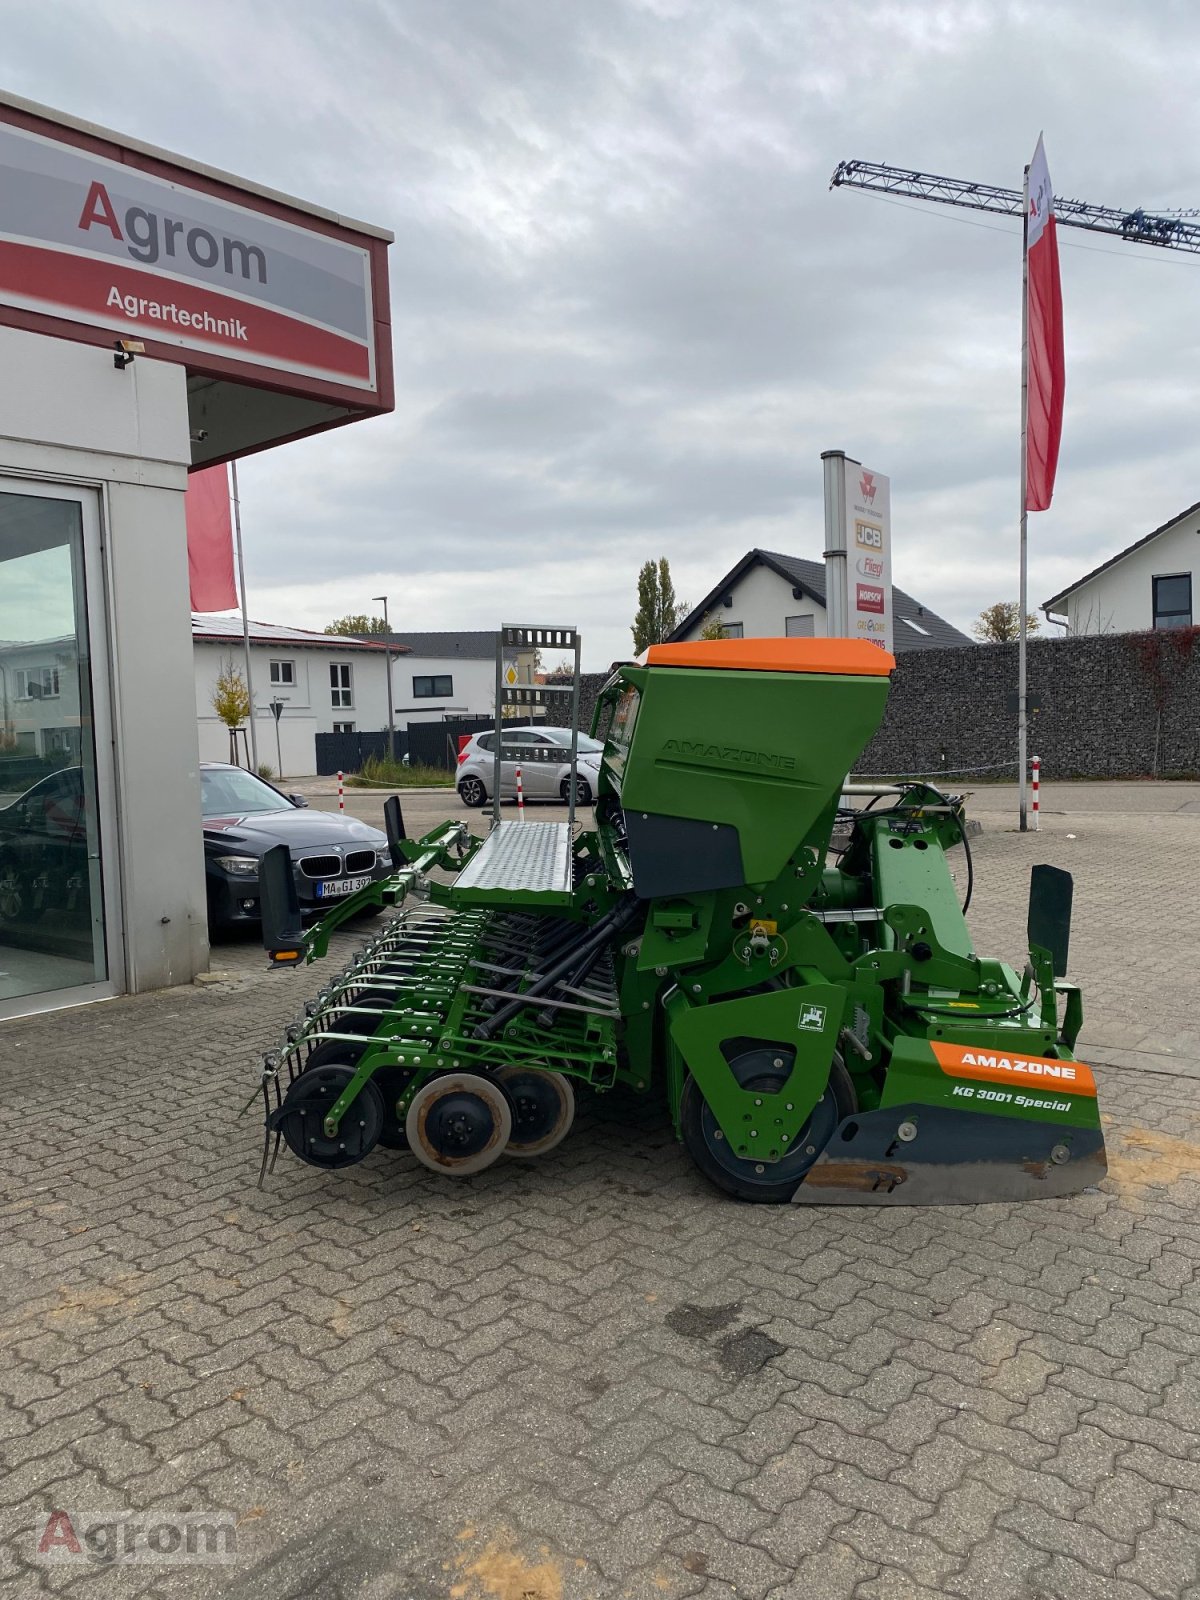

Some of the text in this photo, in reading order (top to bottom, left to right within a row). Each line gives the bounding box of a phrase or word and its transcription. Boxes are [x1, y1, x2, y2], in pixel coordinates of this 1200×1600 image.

[78, 180, 268, 285] Agrom
[106, 286, 248, 341] Agrartechnik
[857, 525, 881, 547] JCB
[859, 590, 882, 603] HORSCH
[662, 739, 796, 769] AMAZONE
[323, 883, 336, 895] MA
[961, 1053, 1076, 1080] AMAZONE
[953, 1086, 1072, 1111] KG 3001 Special
